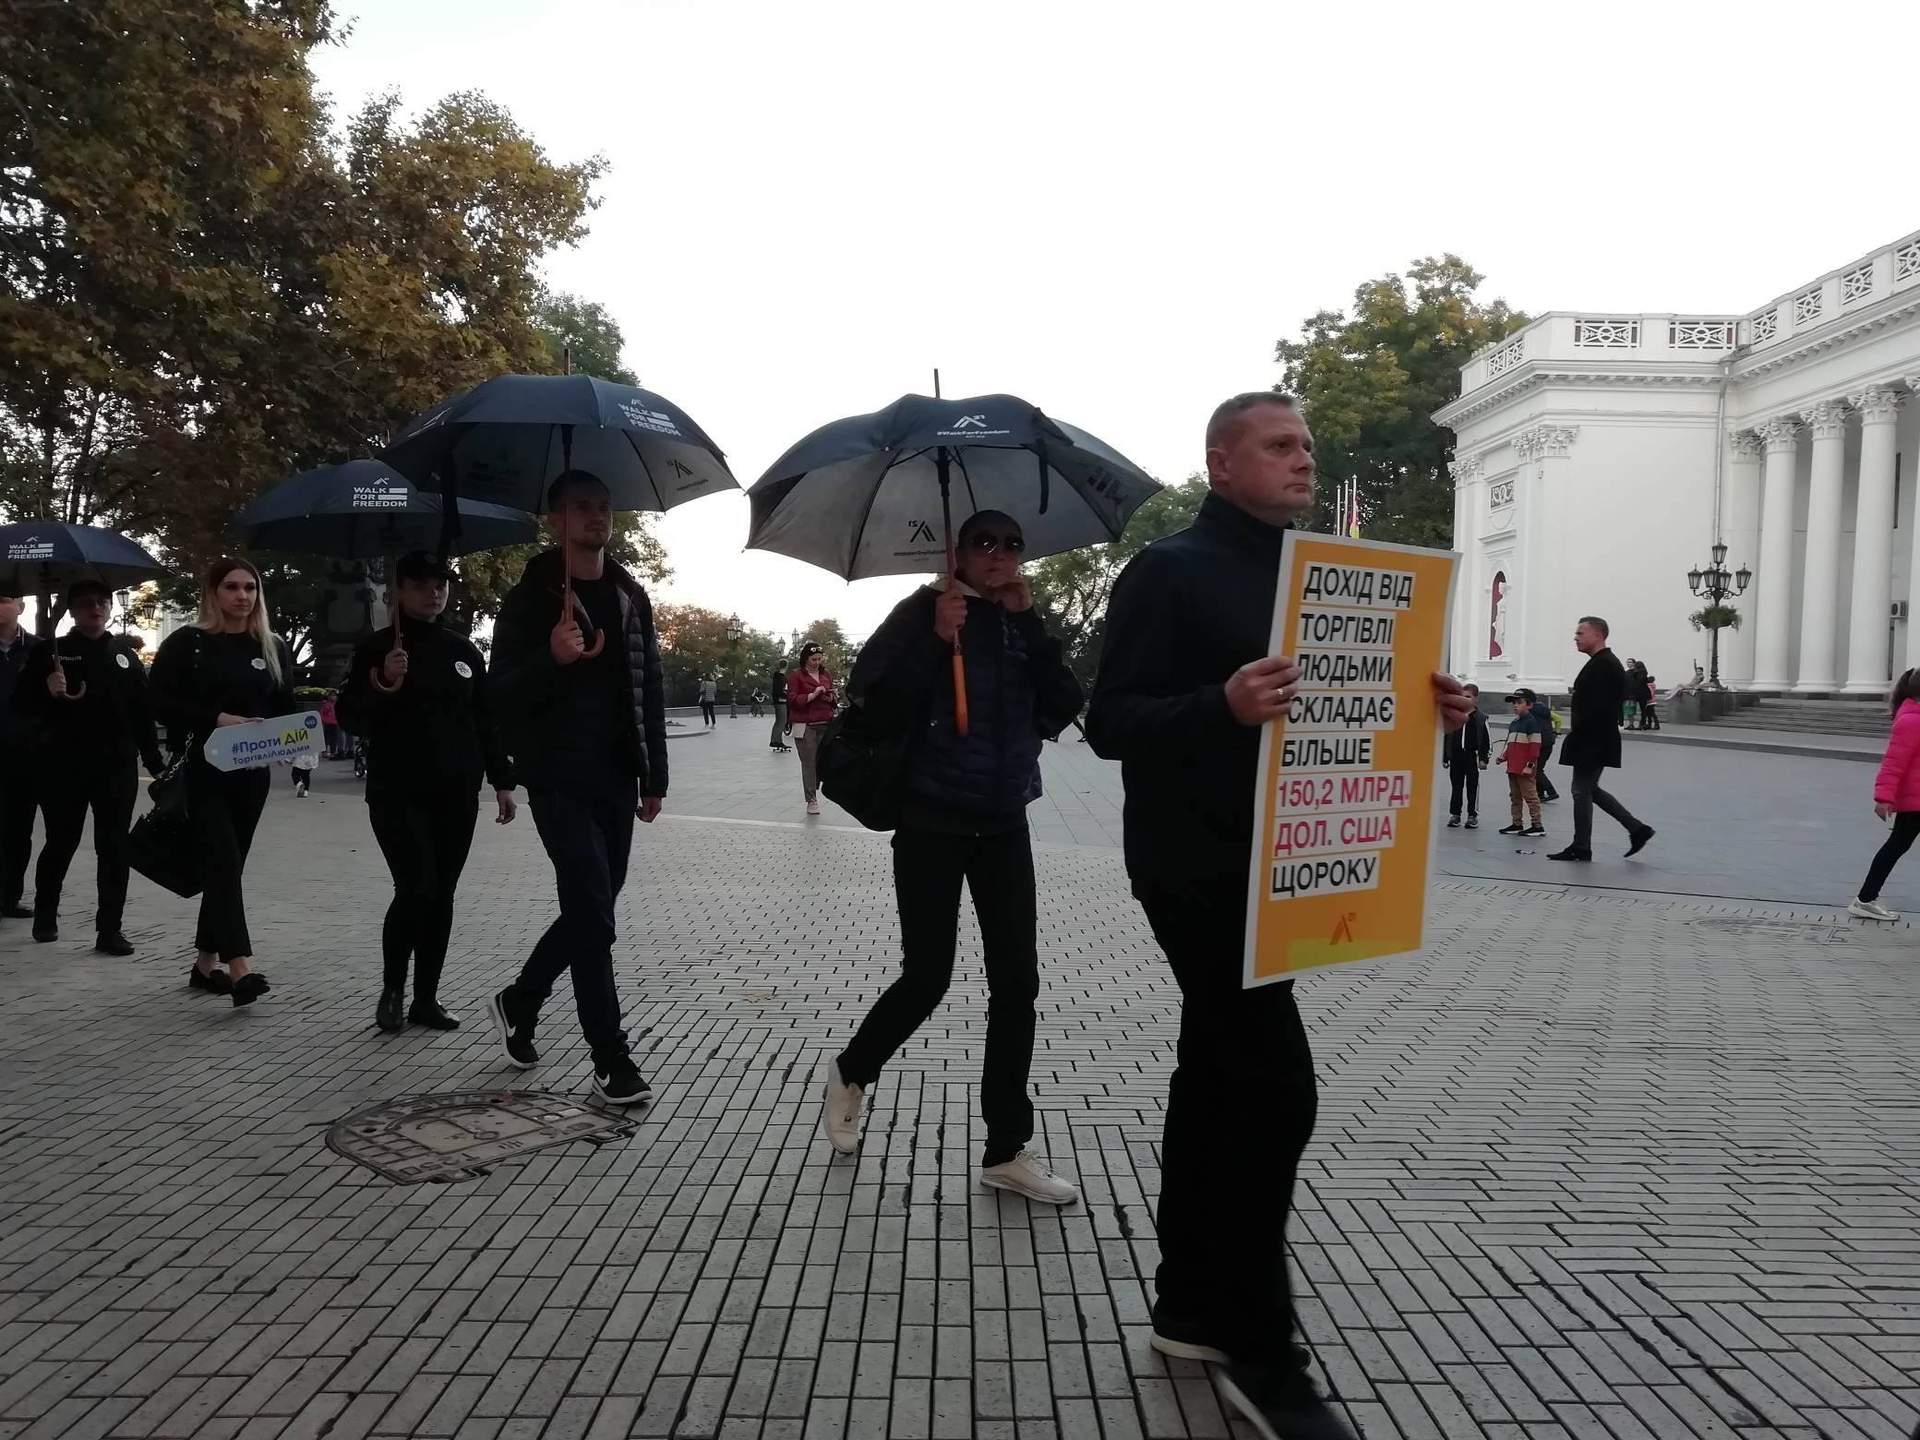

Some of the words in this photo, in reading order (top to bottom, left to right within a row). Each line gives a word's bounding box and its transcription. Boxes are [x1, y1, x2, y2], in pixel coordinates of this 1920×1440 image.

[618, 403, 651, 416] WALK
[624, 411, 648, 422] FOR
[629, 419, 681, 436] FREEDOM
[1303, 565, 1375, 606] ДОХІД
[1379, 573, 1414, 610] ВІД
[1300, 612, 1395, 645] ТОРГІВЛІ
[1299, 653, 1394, 688] ЛЮДЬМИ
[1287, 695, 1395, 729] СКЛАДАЄ
[231, 736, 281, 755] #Проти
[1281, 737, 1373, 768] БІЛЬШЕ
[1278, 778, 1334, 811] 150,2
[1340, 774, 1410, 807] МЛРД.
[1274, 819, 1333, 857] ДОЛ.
[1339, 815, 1393, 846] США
[1271, 856, 1378, 898] ЩОРОКУ
